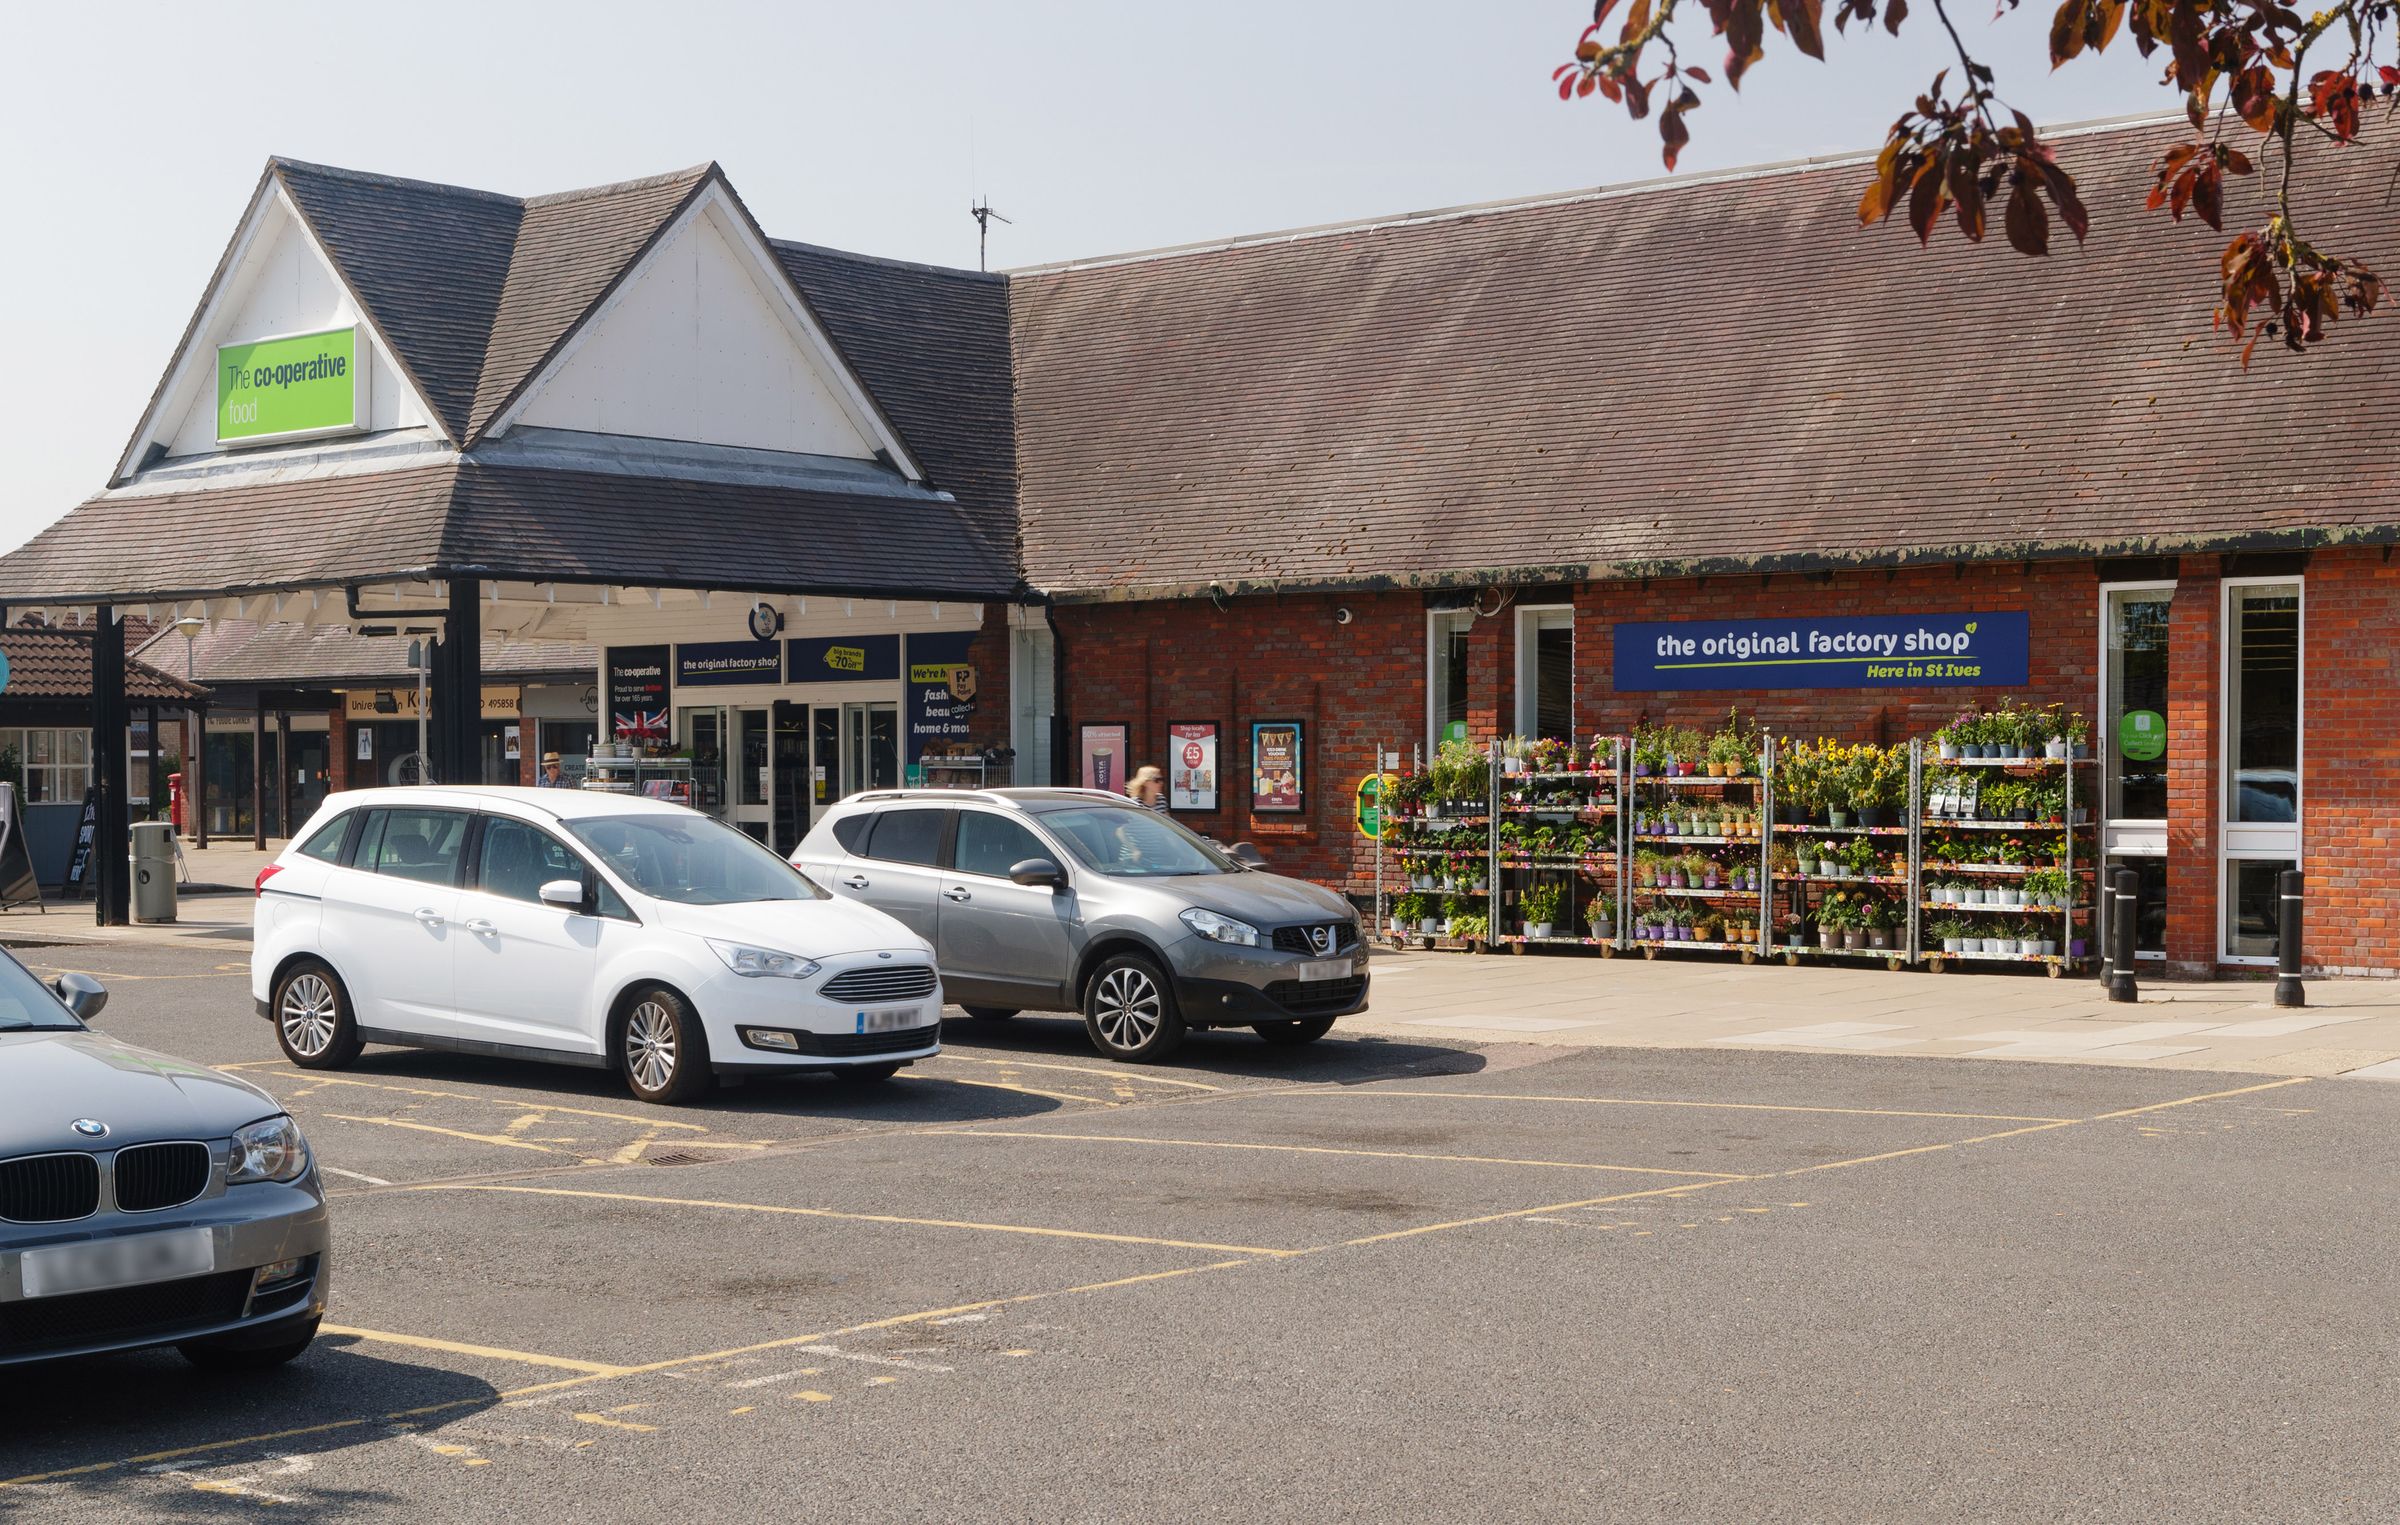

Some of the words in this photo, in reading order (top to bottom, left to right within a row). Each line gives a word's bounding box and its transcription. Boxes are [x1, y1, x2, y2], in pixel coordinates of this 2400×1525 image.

[228, 366, 250, 390] The
[229, 398, 257, 424] food
[1656, 634, 1696, 656] the
[1702, 631, 1800, 659] original
[1808, 630, 1898, 656] factory
[1904, 628, 1970, 655] shop
[684, 660, 696, 670] the
[698, 658, 728, 670] original
[730, 658, 756, 668] factory
[758, 657, 778, 668] shop
[1866, 664, 1904, 678] Here
[1906, 662, 1922, 678] in
[1925, 663, 1943, 677] St
[1945, 663, 1981, 677] Ives
[613, 666, 624, 677] The
[914, 668, 938, 678] We're
[924, 688, 949, 703] fash
[914, 722, 941, 734] home
[943, 723, 950, 733] &
[1186, 746, 1200, 760] £5
